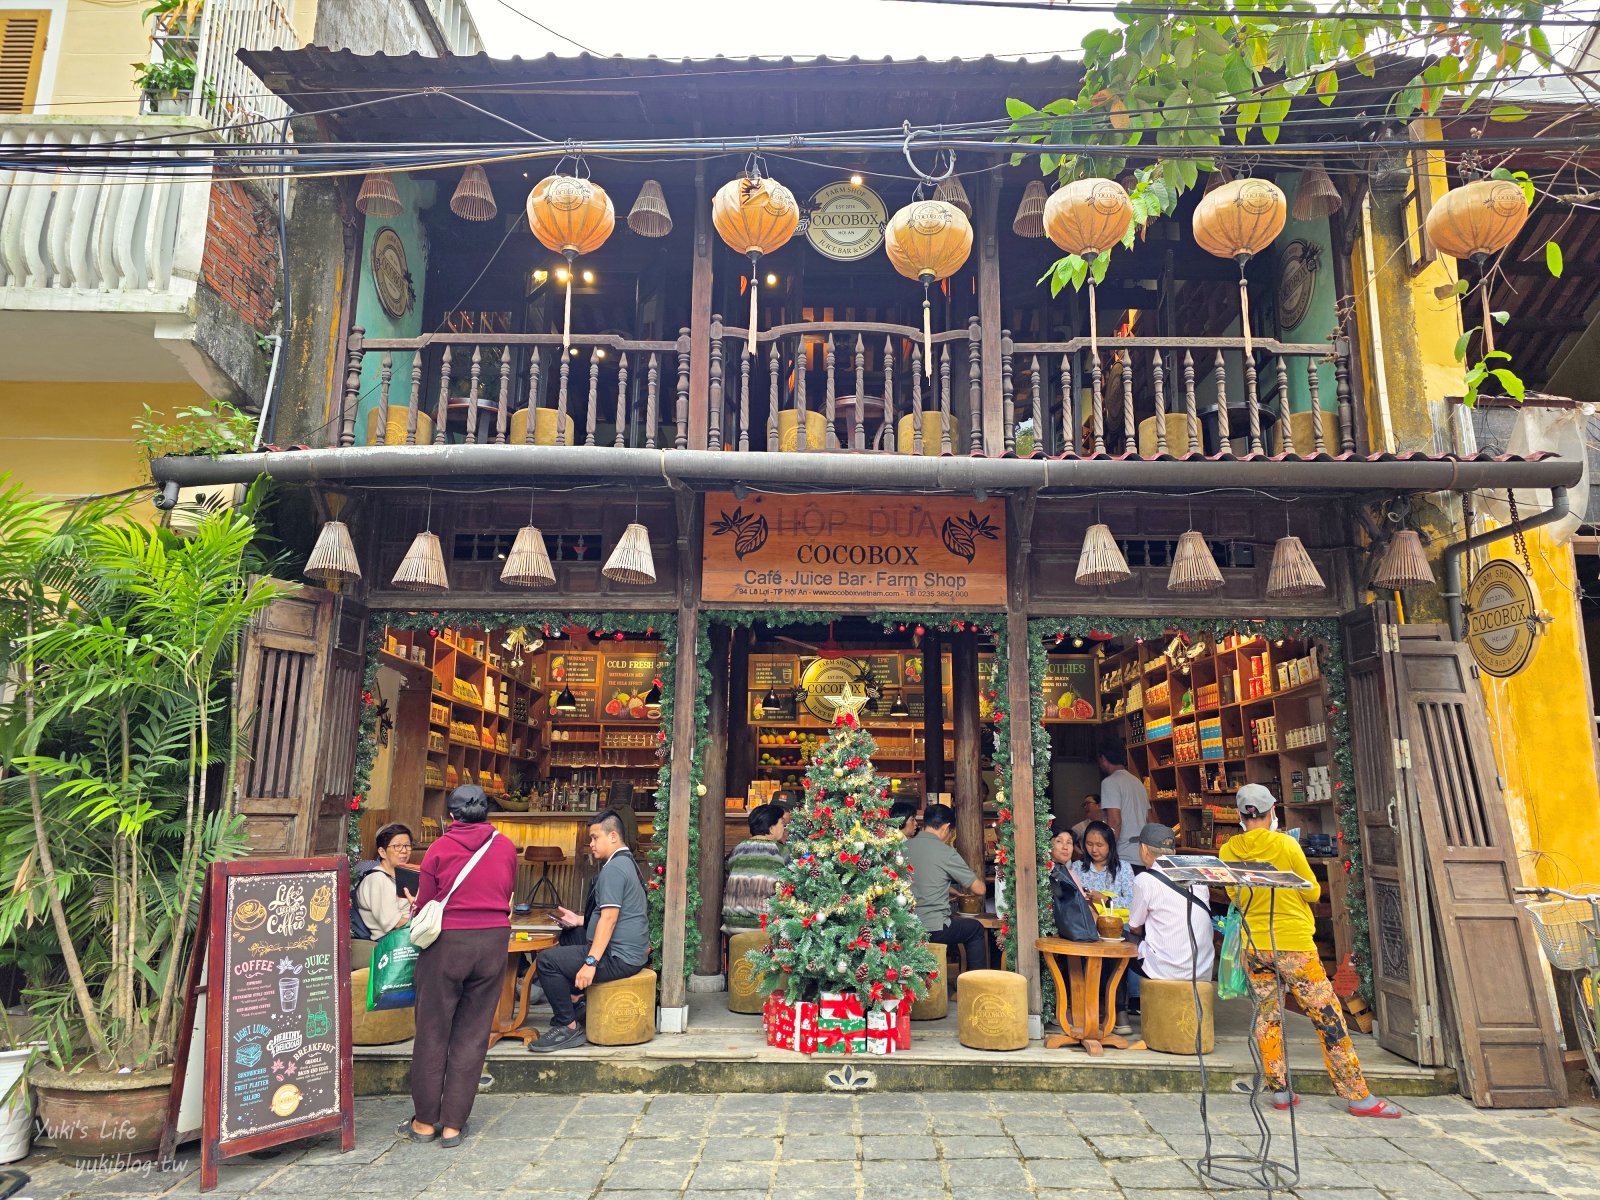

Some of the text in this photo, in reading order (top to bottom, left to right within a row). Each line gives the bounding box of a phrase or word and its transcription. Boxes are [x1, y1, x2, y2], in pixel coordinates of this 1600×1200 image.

[825, 187, 846, 198] FARM
[812, 214, 879, 226] COCOBOX
[818, 239, 837, 252] JUICE
[797, 544, 919, 565] COCOBOX
[744, 569, 966, 590] Café Juice Bar Farm Shop
[1495, 568, 1513, 582] SHOP
[1472, 603, 1527, 633] COCOBOX
[607, 660, 627, 669] COLD
[629, 660, 654, 669] FRESH
[268, 884, 305, 911] Life
[267, 913, 306, 937] Coffee
[234, 960, 275, 976] COFFEE
[304, 954, 331, 969] JUICE
[233, 1023, 273, 1043] LIGHT LUNCH
[273, 1029, 301, 1045] HEALTHY
[293, 1042, 336, 1061] BREAKFAST
[234, 1083, 249, 1092] FRUIT
[249, 1079, 269, 1089] PLATTER
